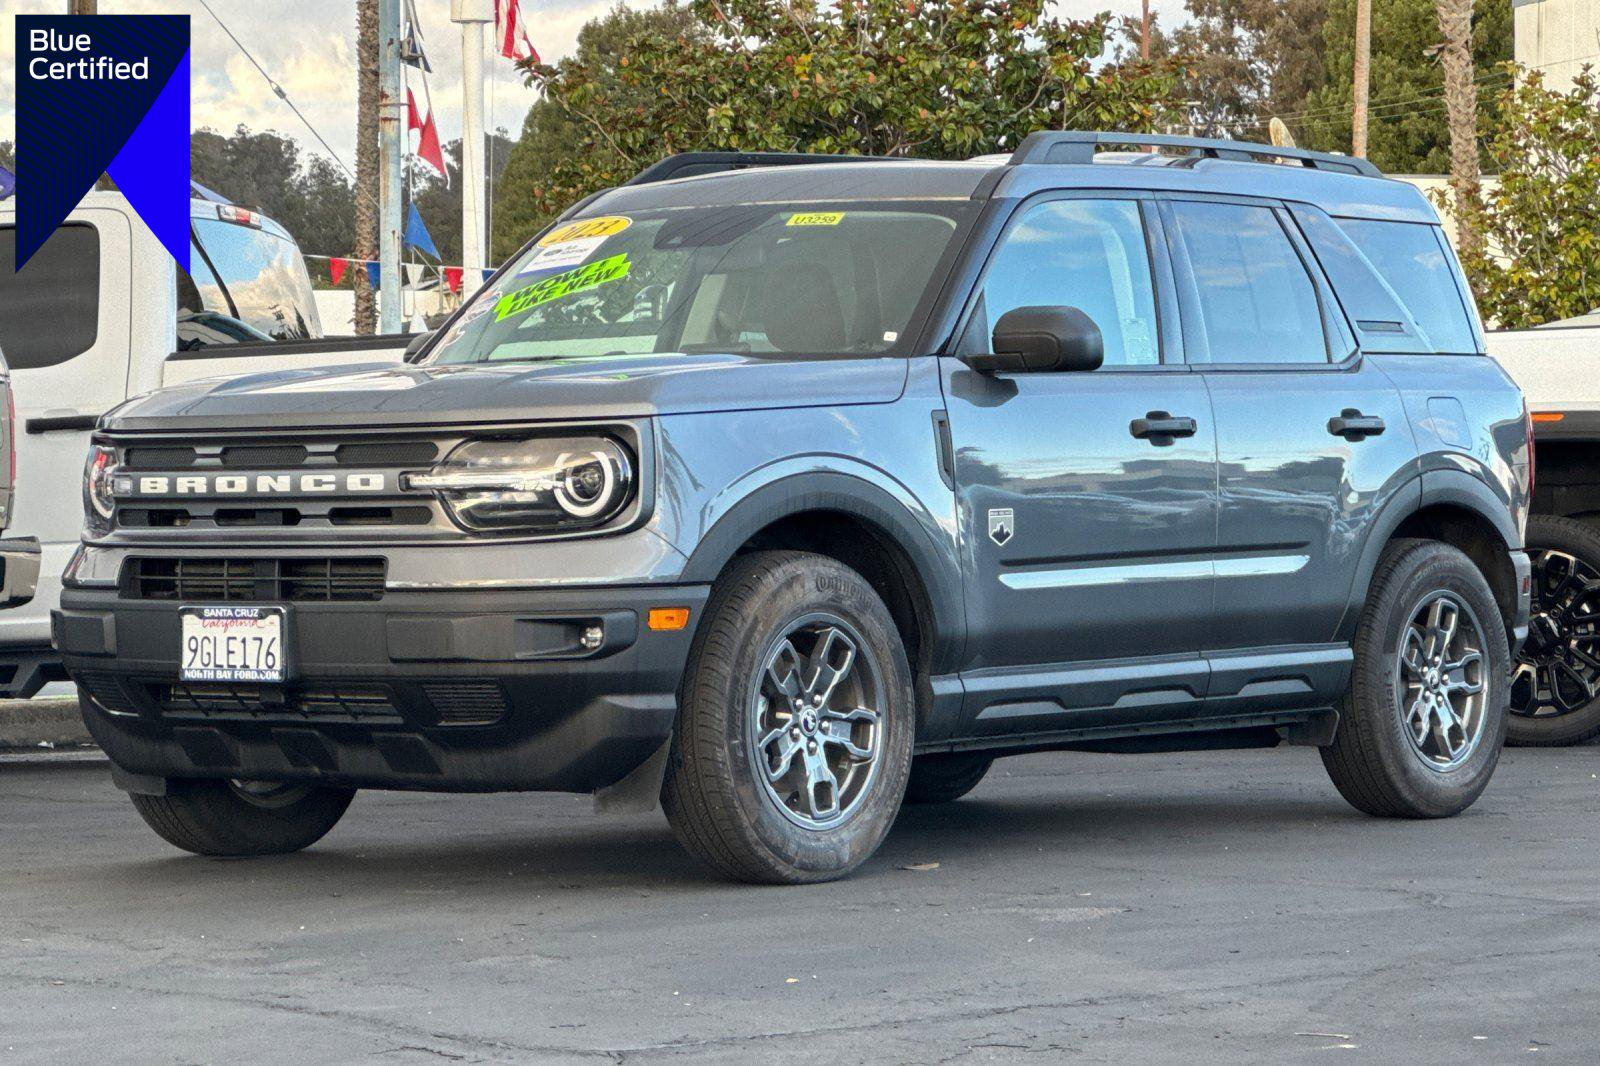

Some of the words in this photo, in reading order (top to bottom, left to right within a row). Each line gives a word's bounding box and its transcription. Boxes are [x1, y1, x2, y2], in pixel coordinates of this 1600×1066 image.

[506, 288, 554, 315] LIKE
[560, 265, 622, 294] NEW
[140, 474, 385, 493] BRONCO
[203, 608, 234, 617] SANTA
[235, 608, 259, 617] CRUZ
[202, 619, 264, 633] California
[188, 635, 276, 669] 9GLE176
[184, 670, 215, 679] NORTH
[216, 670, 232, 679] BAY
